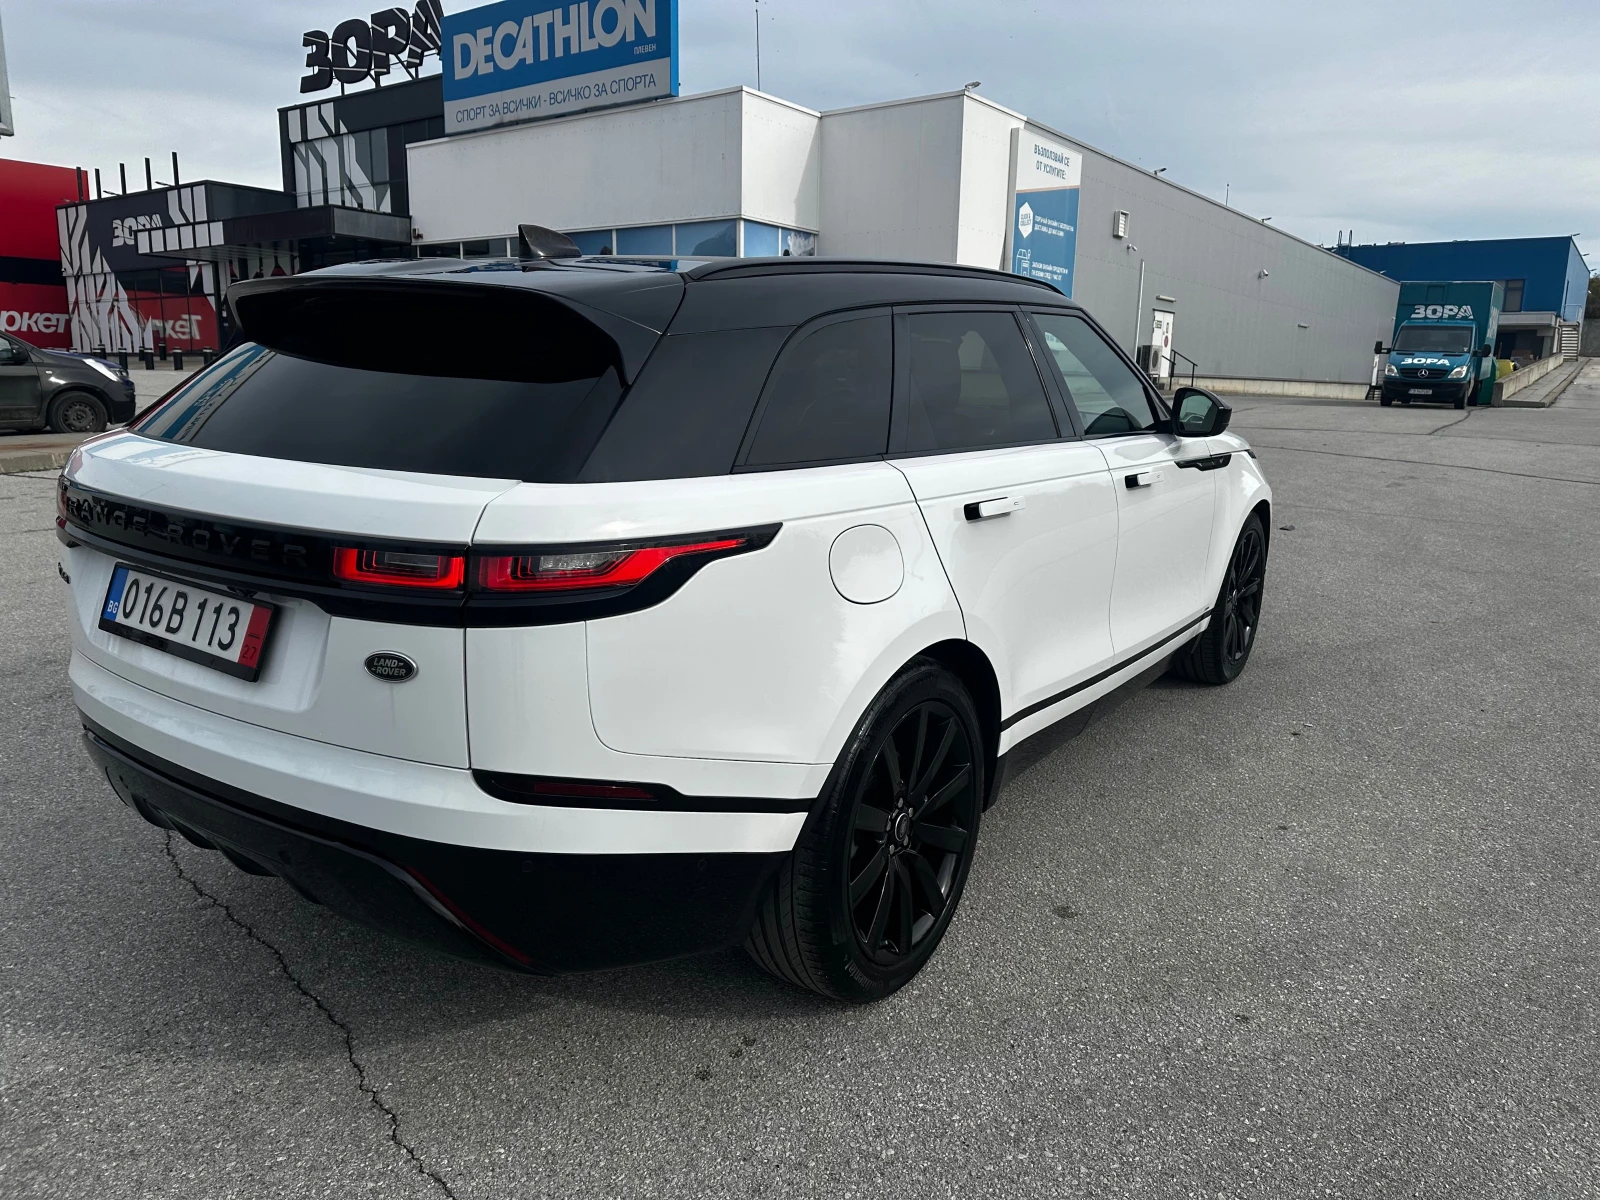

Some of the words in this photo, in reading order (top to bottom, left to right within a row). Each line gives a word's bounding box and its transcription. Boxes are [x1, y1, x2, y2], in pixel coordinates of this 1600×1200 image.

[300, 0, 443, 93] ЗОРА
[453, 0, 656, 80] DECATHLON
[633, 43, 657, 55] ПЛЕВЕН
[455, 106, 487, 123] СПОРТ
[488, 103, 501, 117] ЗА
[502, 95, 541, 115] ВСИЧКИ
[549, 85, 591, 106] ВСИЧКО
[593, 83, 608, 98] ЗА
[610, 73, 656, 95] СПОРТА
[1034, 144, 1063, 164] ВЪЗПОЛЗВАЙ
[1064, 157, 1070, 167] СЕ
[1036, 160, 1042, 171] ОТ
[1043, 163, 1066, 180] УСЛУГИТЕ:
[1410, 305, 1474, 319] ЗОРА
[1400, 357, 1451, 366] ЗОРА
[68, 498, 148, 535] RANGE
[167, 524, 307, 567] ROVER
[107, 600, 118, 613] BG
[242, 644, 256, 660] 27
[374, 657, 398, 669] LAND
[376, 666, 406, 677] ROVER
